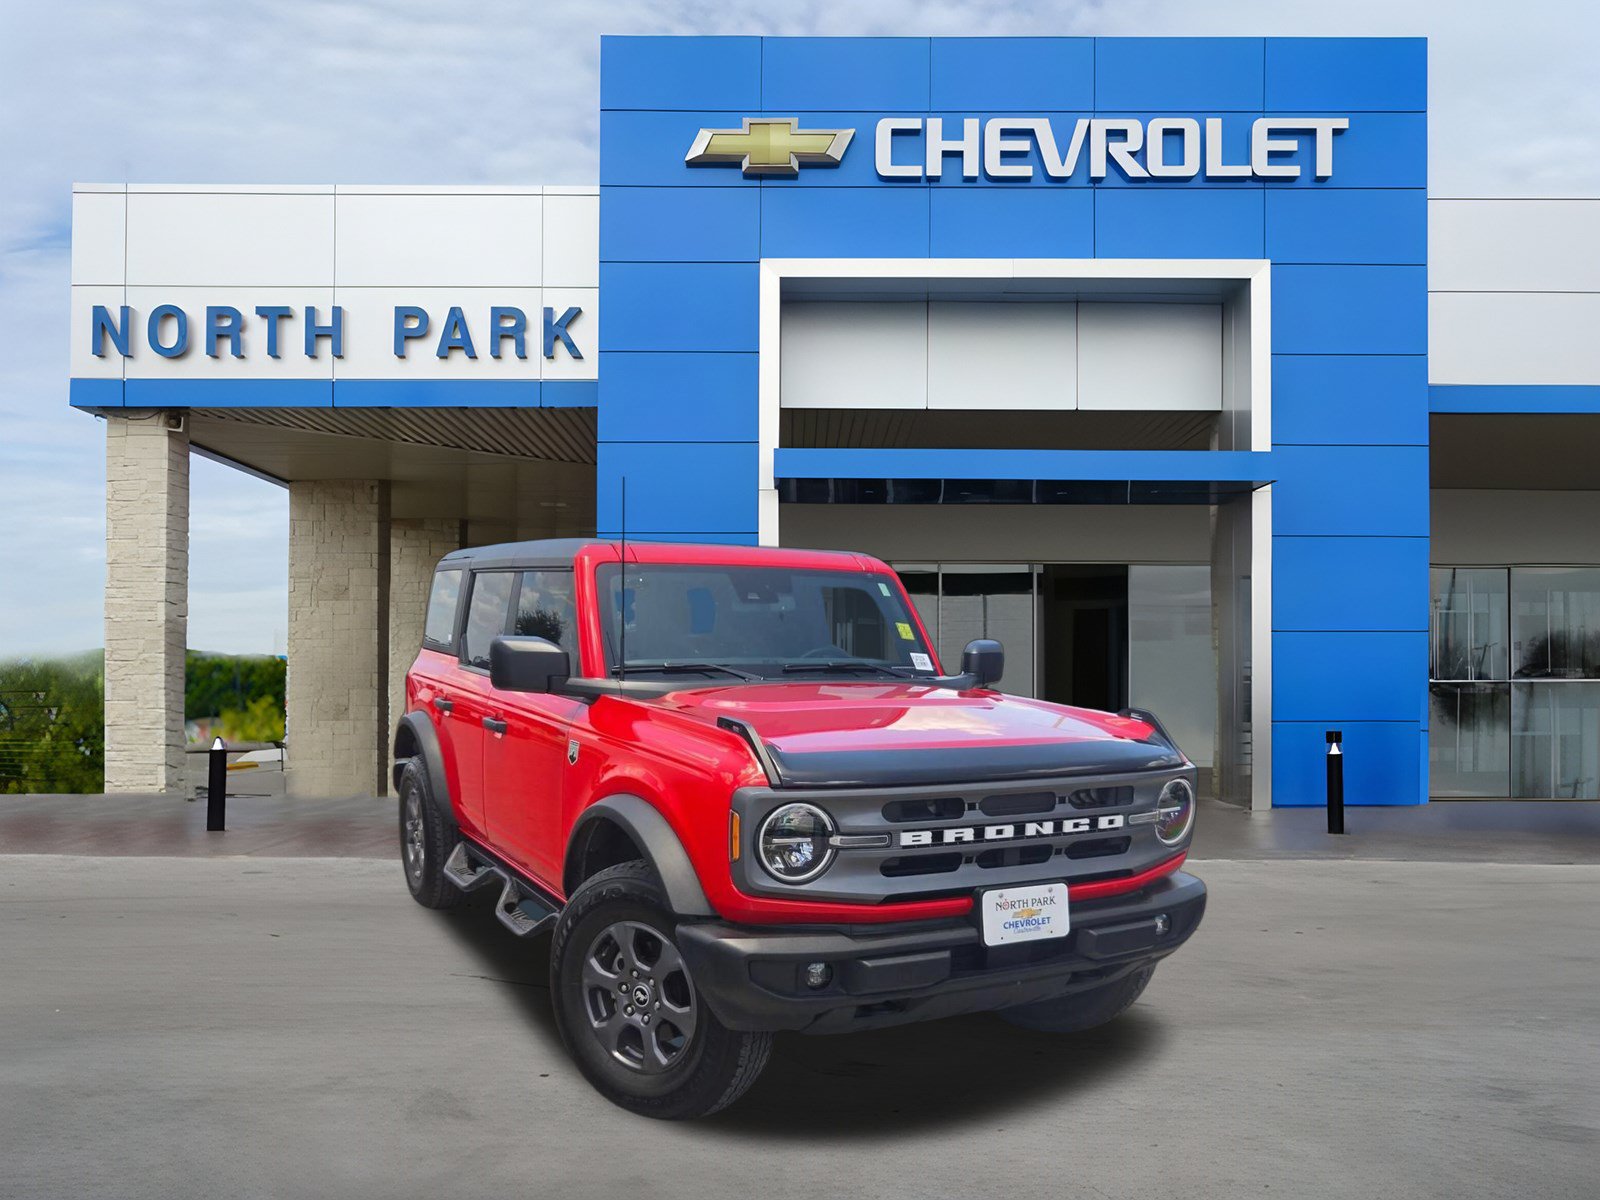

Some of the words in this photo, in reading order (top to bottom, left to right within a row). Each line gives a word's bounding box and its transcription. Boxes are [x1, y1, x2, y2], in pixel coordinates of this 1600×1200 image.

[875, 117, 1350, 180] CHEVROLET
[92, 304, 345, 360] NORTH
[393, 305, 585, 360] PARK
[900, 814, 1124, 846] BRONCO
[995, 898, 1028, 911] NORTH
[1031, 896, 1056, 907] PARK
[1003, 917, 1051, 929] CHEVROLET
